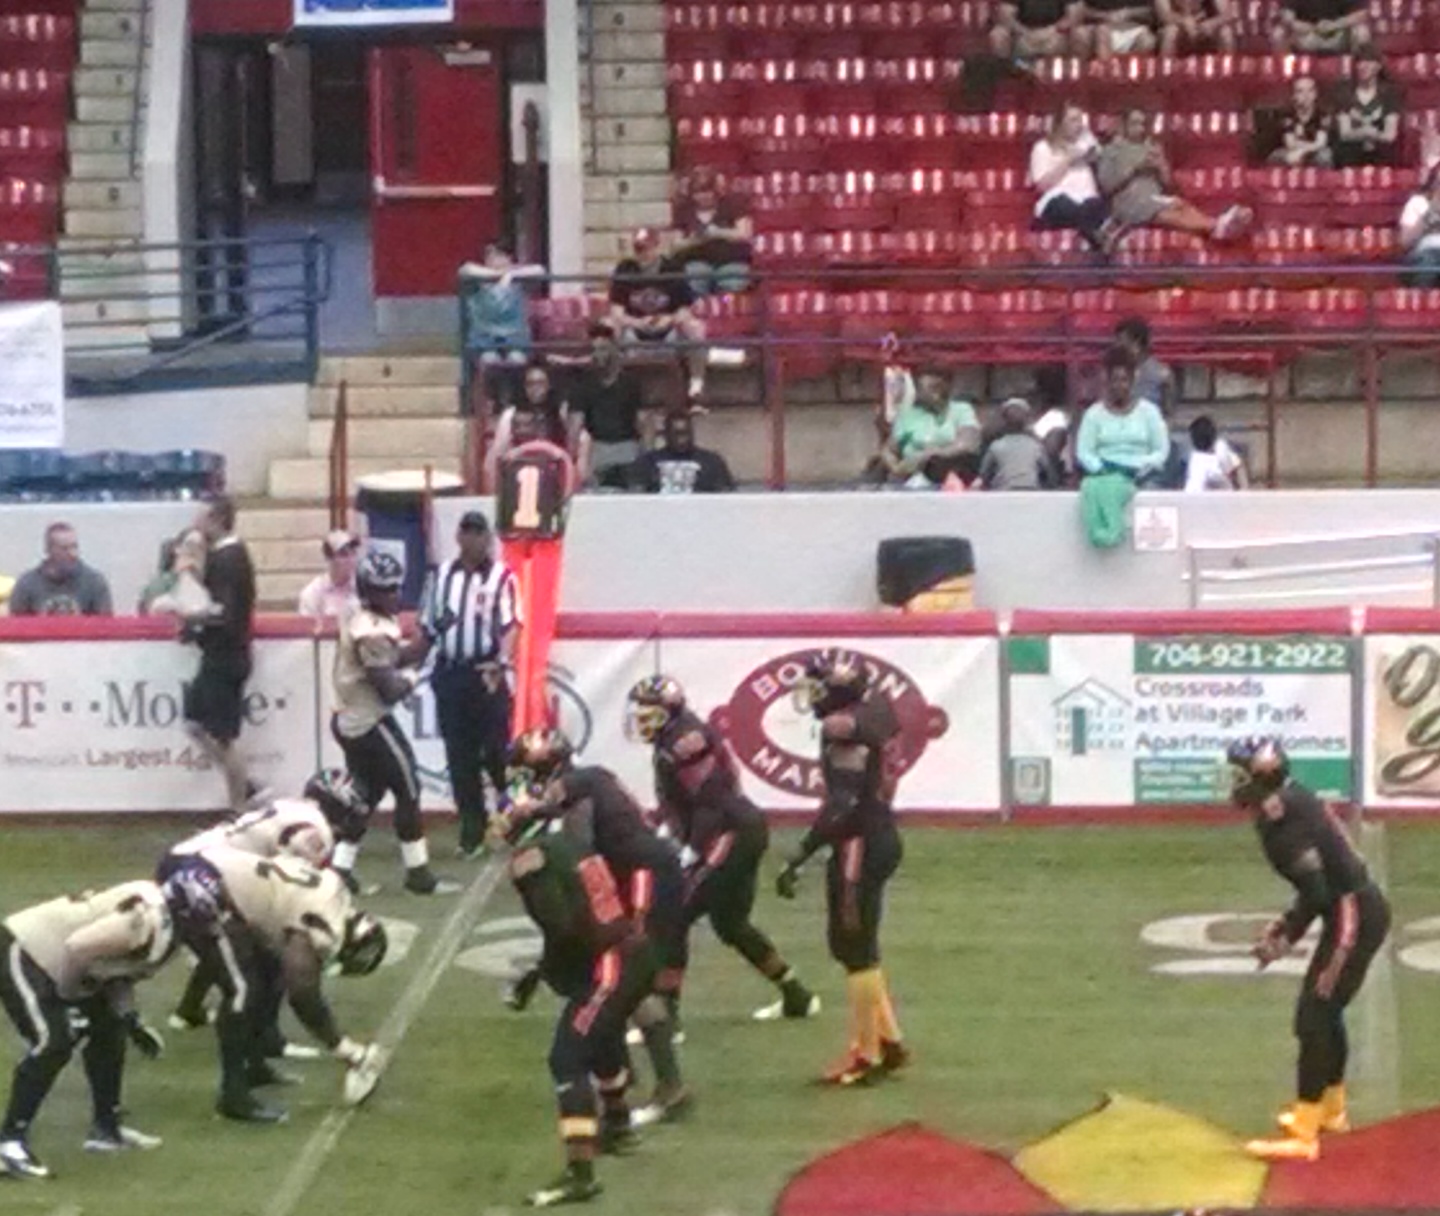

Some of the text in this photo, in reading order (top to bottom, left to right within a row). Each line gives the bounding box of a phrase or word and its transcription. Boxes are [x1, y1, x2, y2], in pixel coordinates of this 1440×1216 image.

[513, 465, 541, 529] 1
[1151, 642, 1347, 668] 704-921-2922
[1134, 677, 1265, 697] Crossroads
[1134, 702, 1307, 728] at Village Park
[85, 747, 172, 771] Largest
